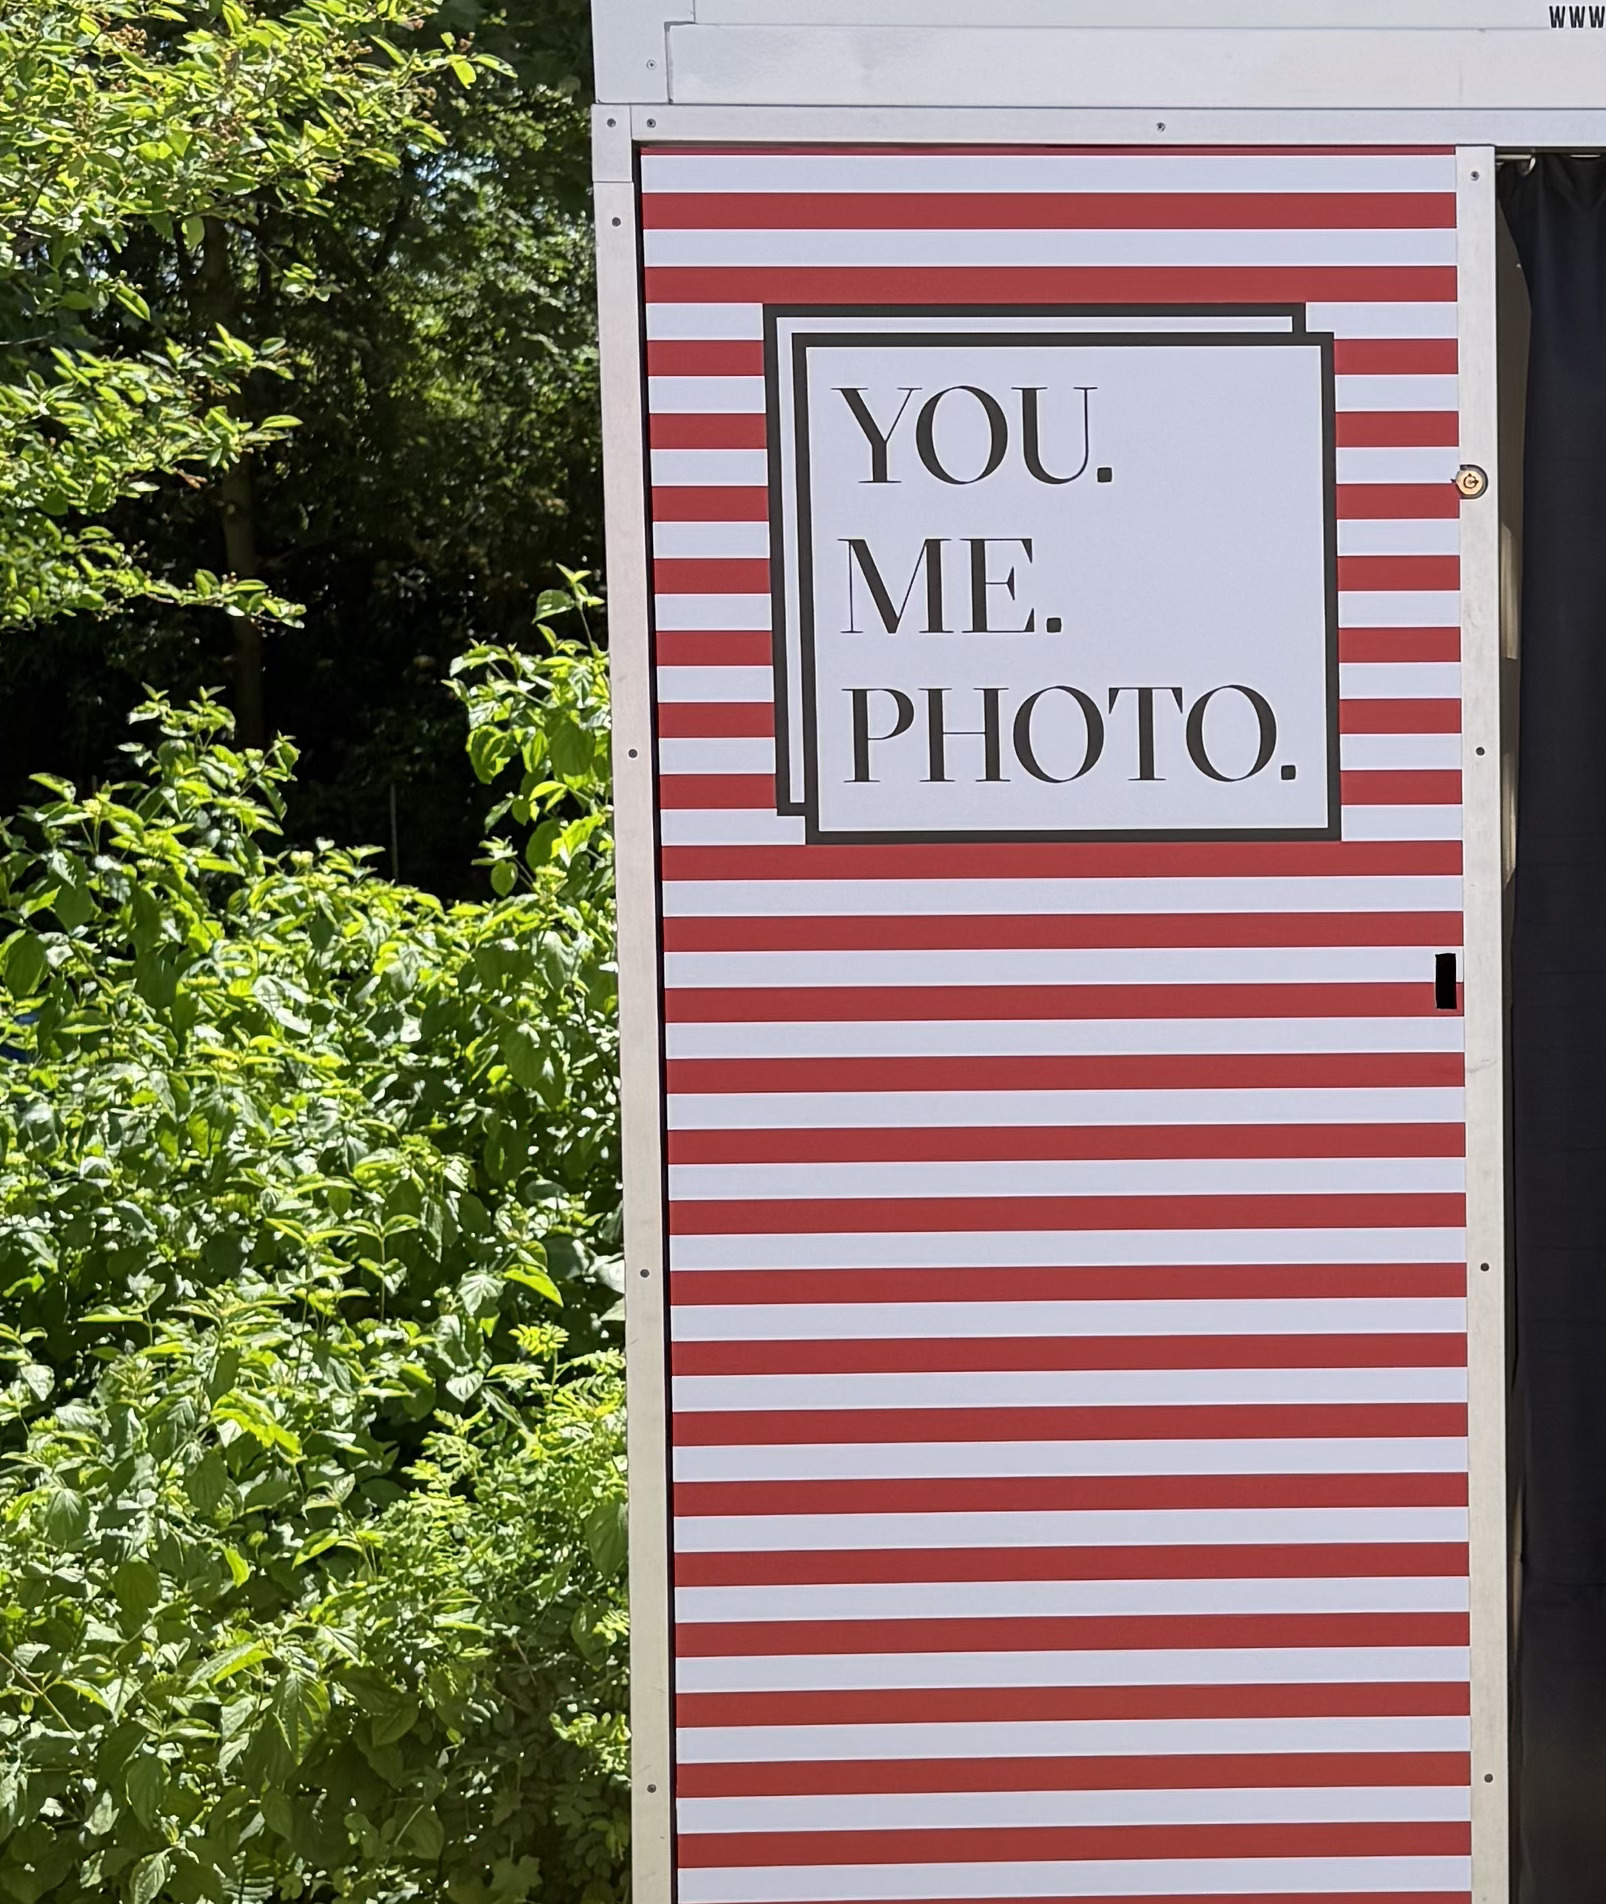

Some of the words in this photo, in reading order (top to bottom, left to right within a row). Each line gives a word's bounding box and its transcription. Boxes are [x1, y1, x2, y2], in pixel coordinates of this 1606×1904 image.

[831, 385, 1113, 485] YOU.
[836, 538, 1062, 634] ME.
[842, 684, 1297, 783] PHOTO.
